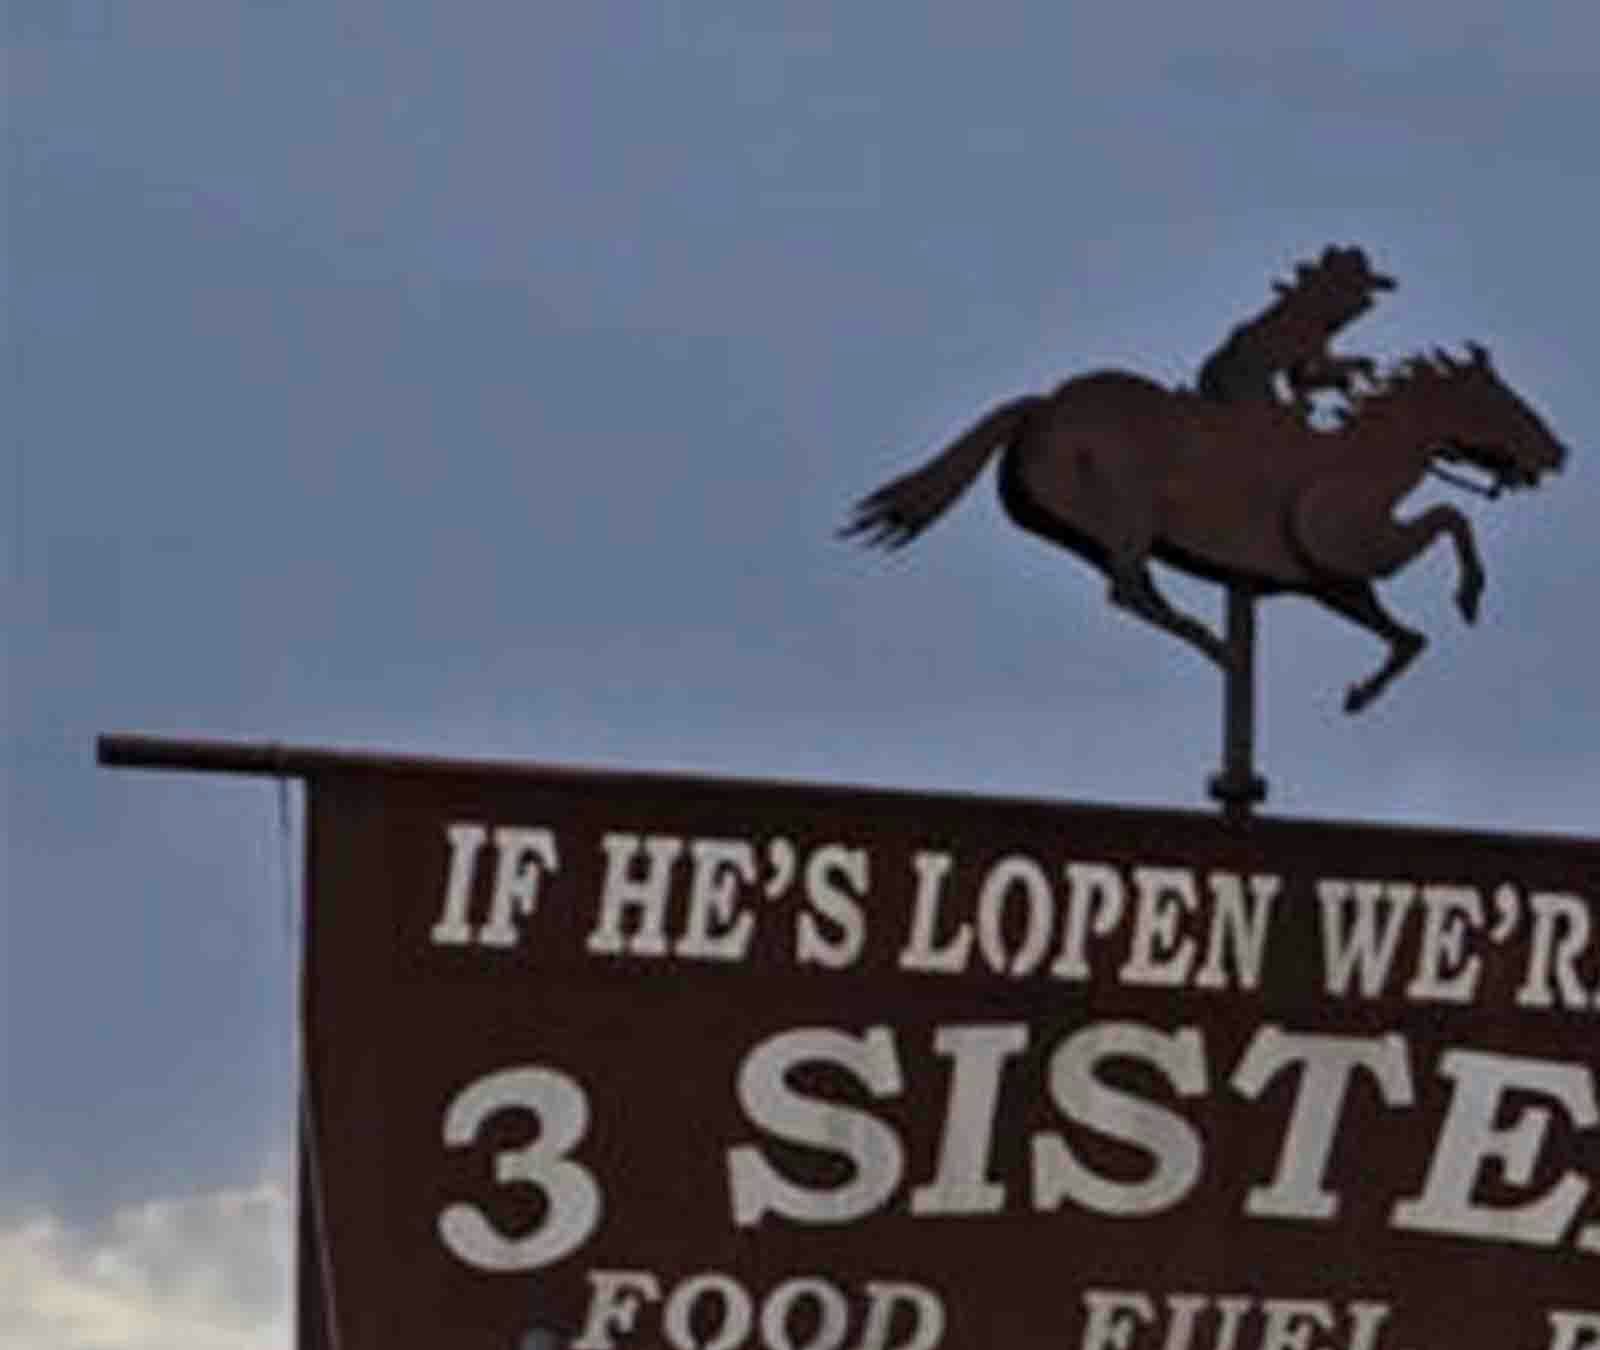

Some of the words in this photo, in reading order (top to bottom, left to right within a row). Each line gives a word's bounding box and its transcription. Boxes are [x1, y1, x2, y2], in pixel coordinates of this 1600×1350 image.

[432, 824, 558, 947] IF
[587, 834, 869, 967] HE'S
[899, 852, 1280, 989] LOPEN
[437, 1067, 601, 1270] 3
